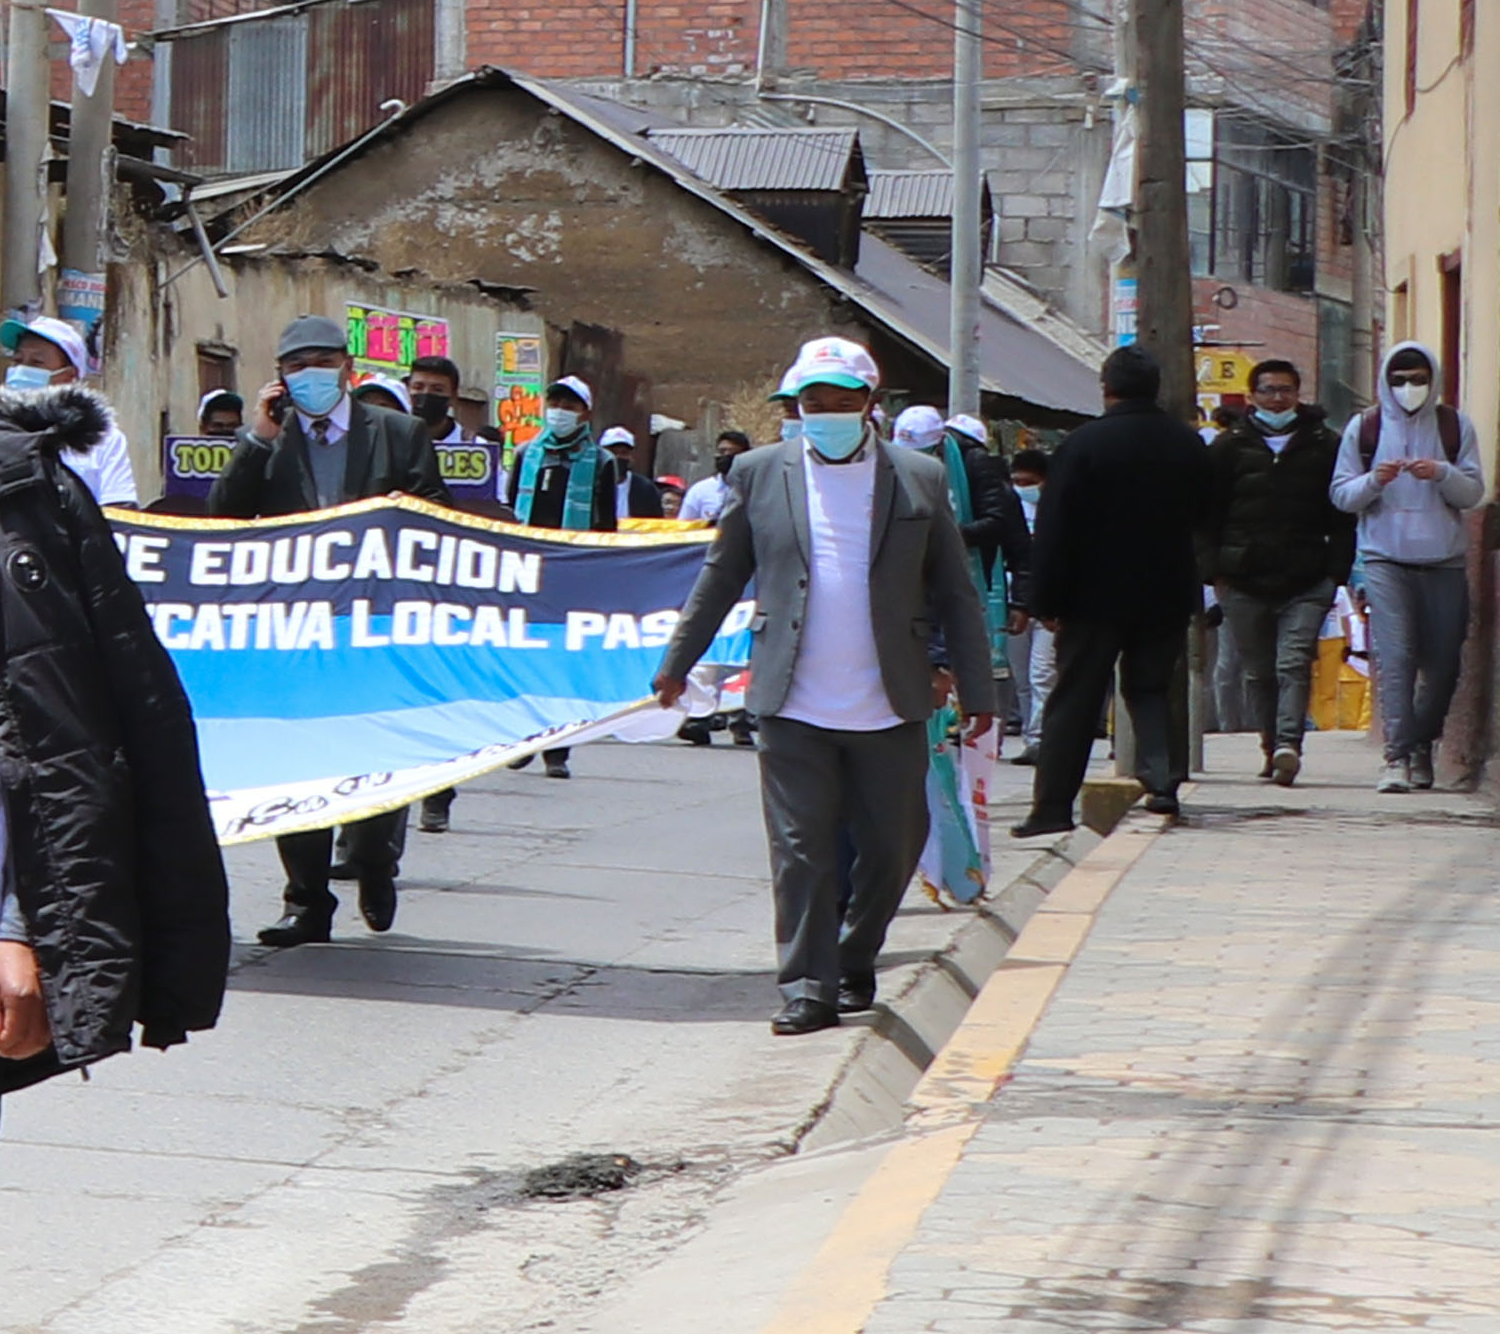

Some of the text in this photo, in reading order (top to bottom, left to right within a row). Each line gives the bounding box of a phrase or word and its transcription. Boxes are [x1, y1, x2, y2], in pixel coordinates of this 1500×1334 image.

[174, 445, 235, 474] TOD
[436, 451, 487, 480] LES
[189, 527, 542, 595] EDUCACION
[145, 598, 757, 652] CATIVA LOCAL PASO
